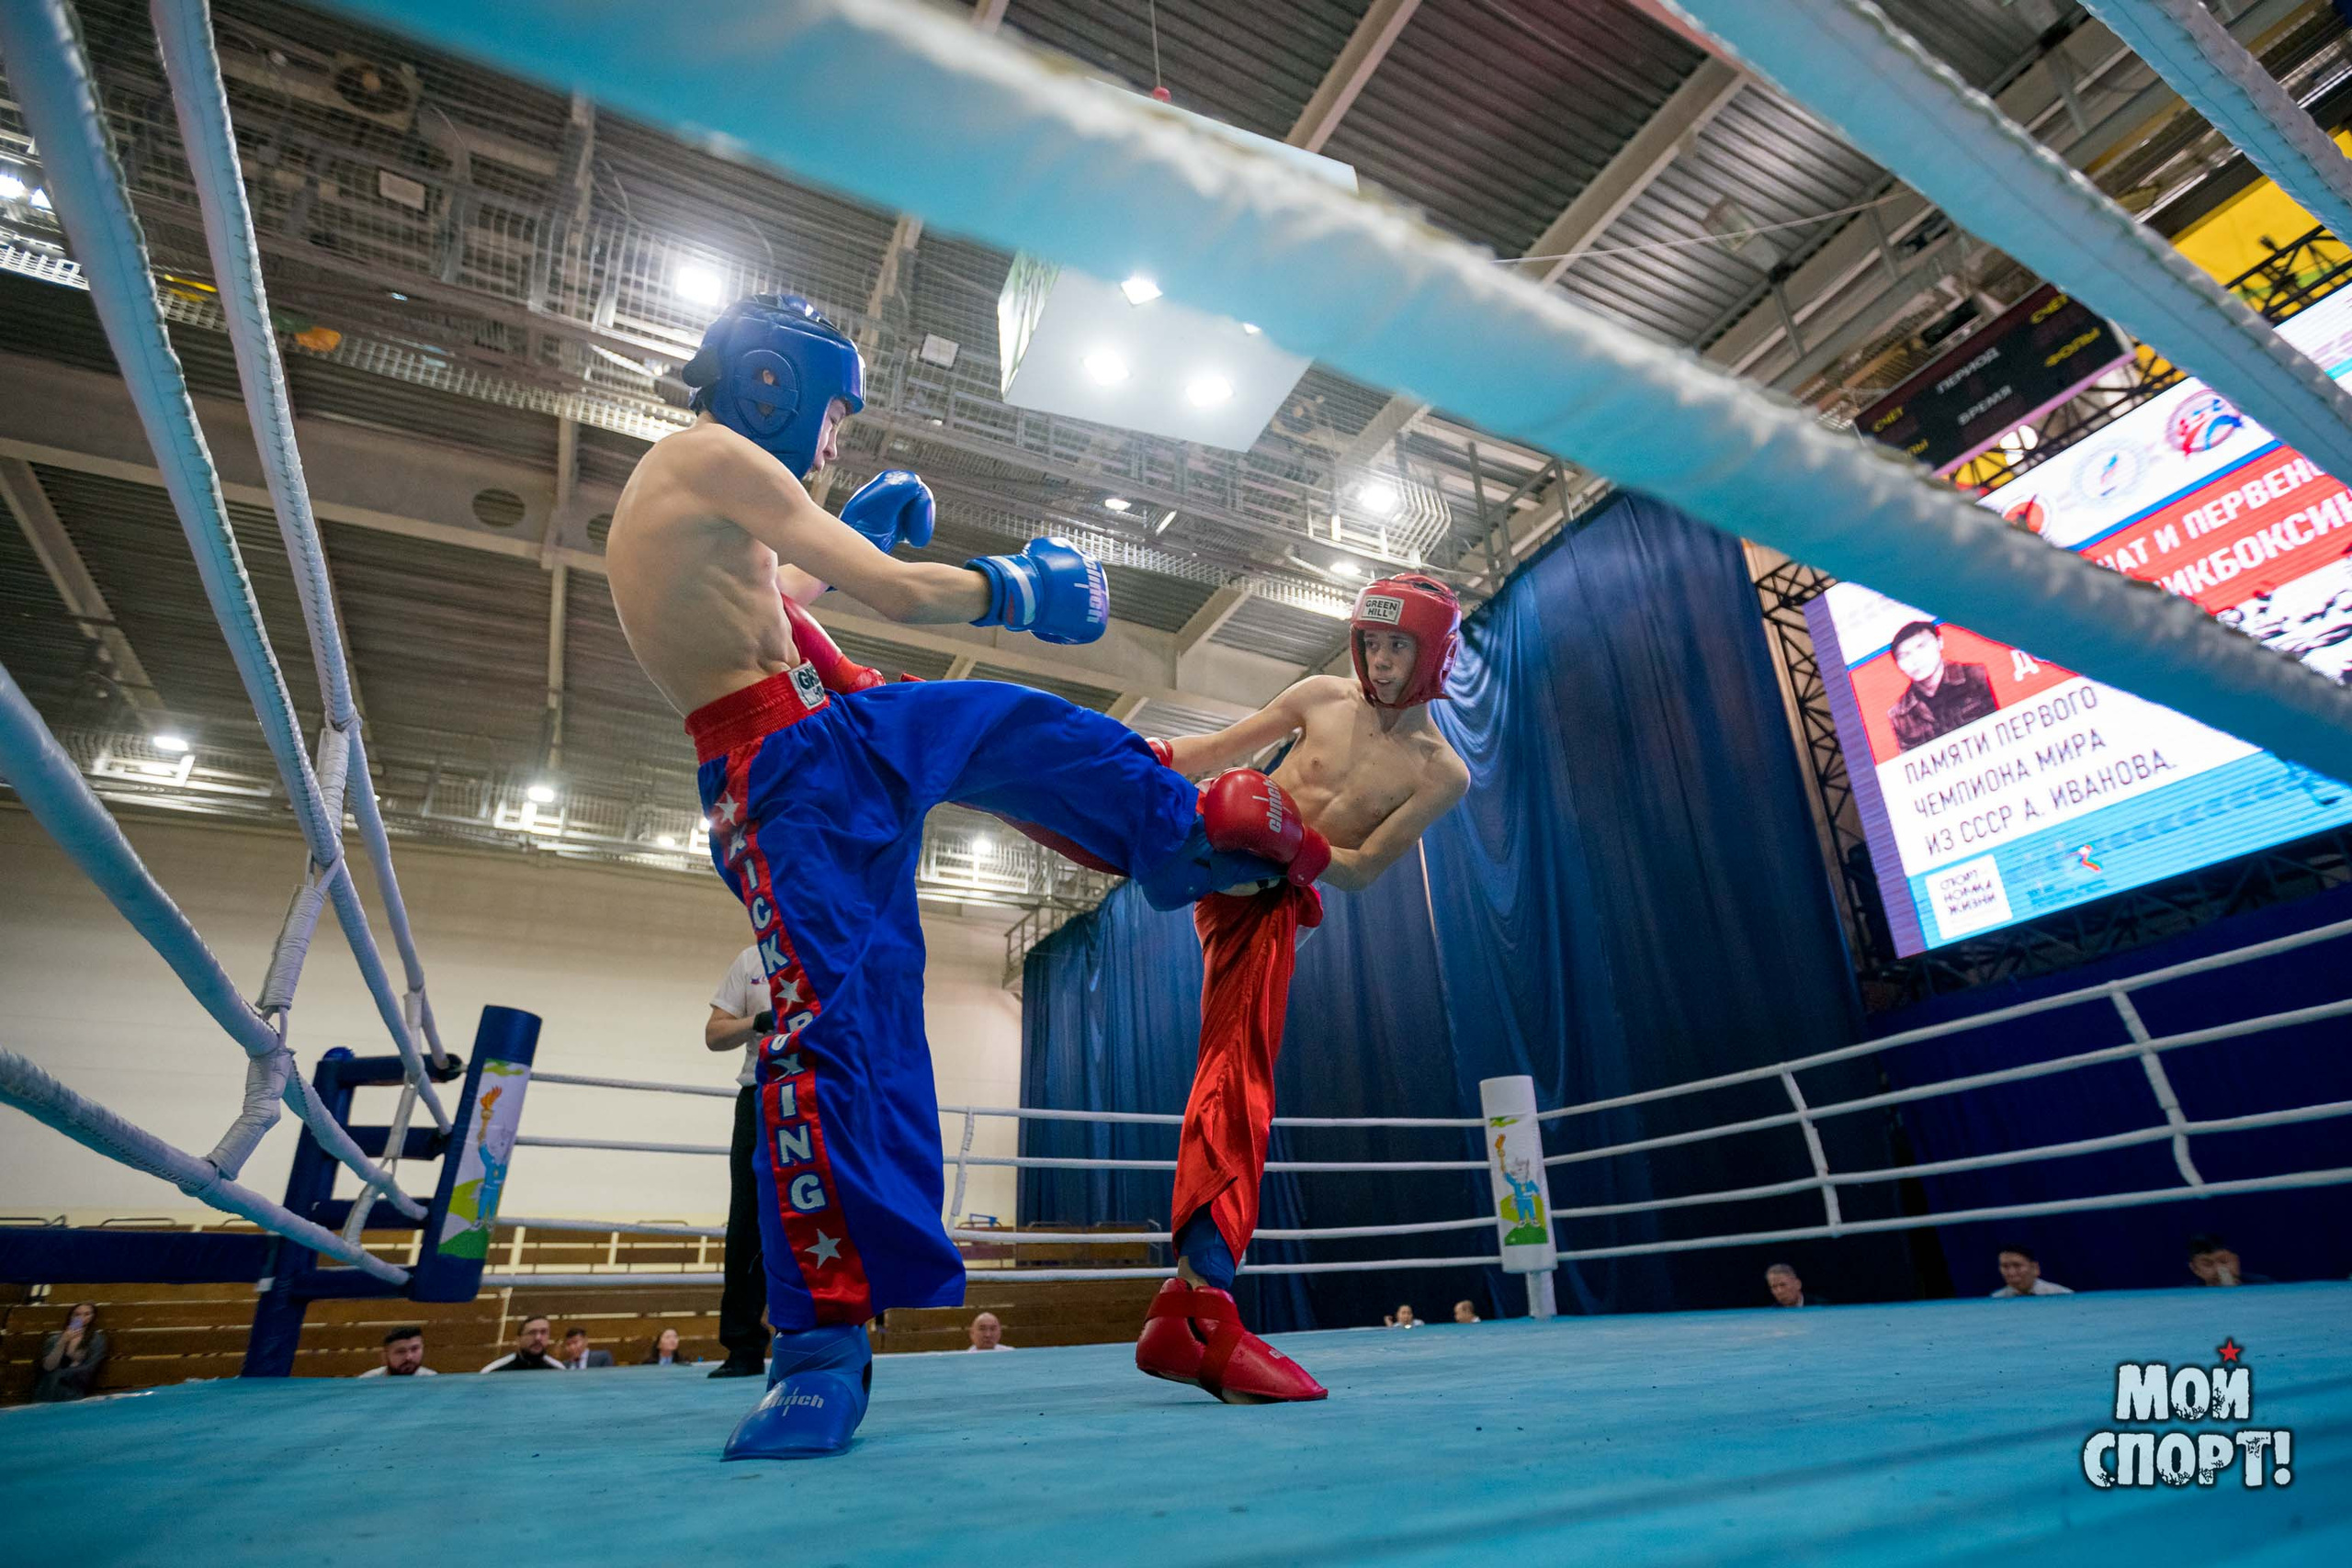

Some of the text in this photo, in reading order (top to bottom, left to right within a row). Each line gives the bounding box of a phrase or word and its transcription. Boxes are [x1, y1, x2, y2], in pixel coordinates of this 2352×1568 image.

[1936, 346, 2000, 394] ПЕРИОД
[1957, 384, 2012, 426] ВРЕМЯ
[1365, 600, 1397, 611] GREEN
[1368, 608, 1388, 617] HILL
[1905, 686, 2098, 784] ПАМЯТИ ПЕРВОГО
[1914, 728, 2107, 818] ЧЕМПИОНА МИРА
[1259, 779, 1286, 834] clinch
[1925, 749, 2178, 855] ИЗ СССР А. ИВАНОВА.
